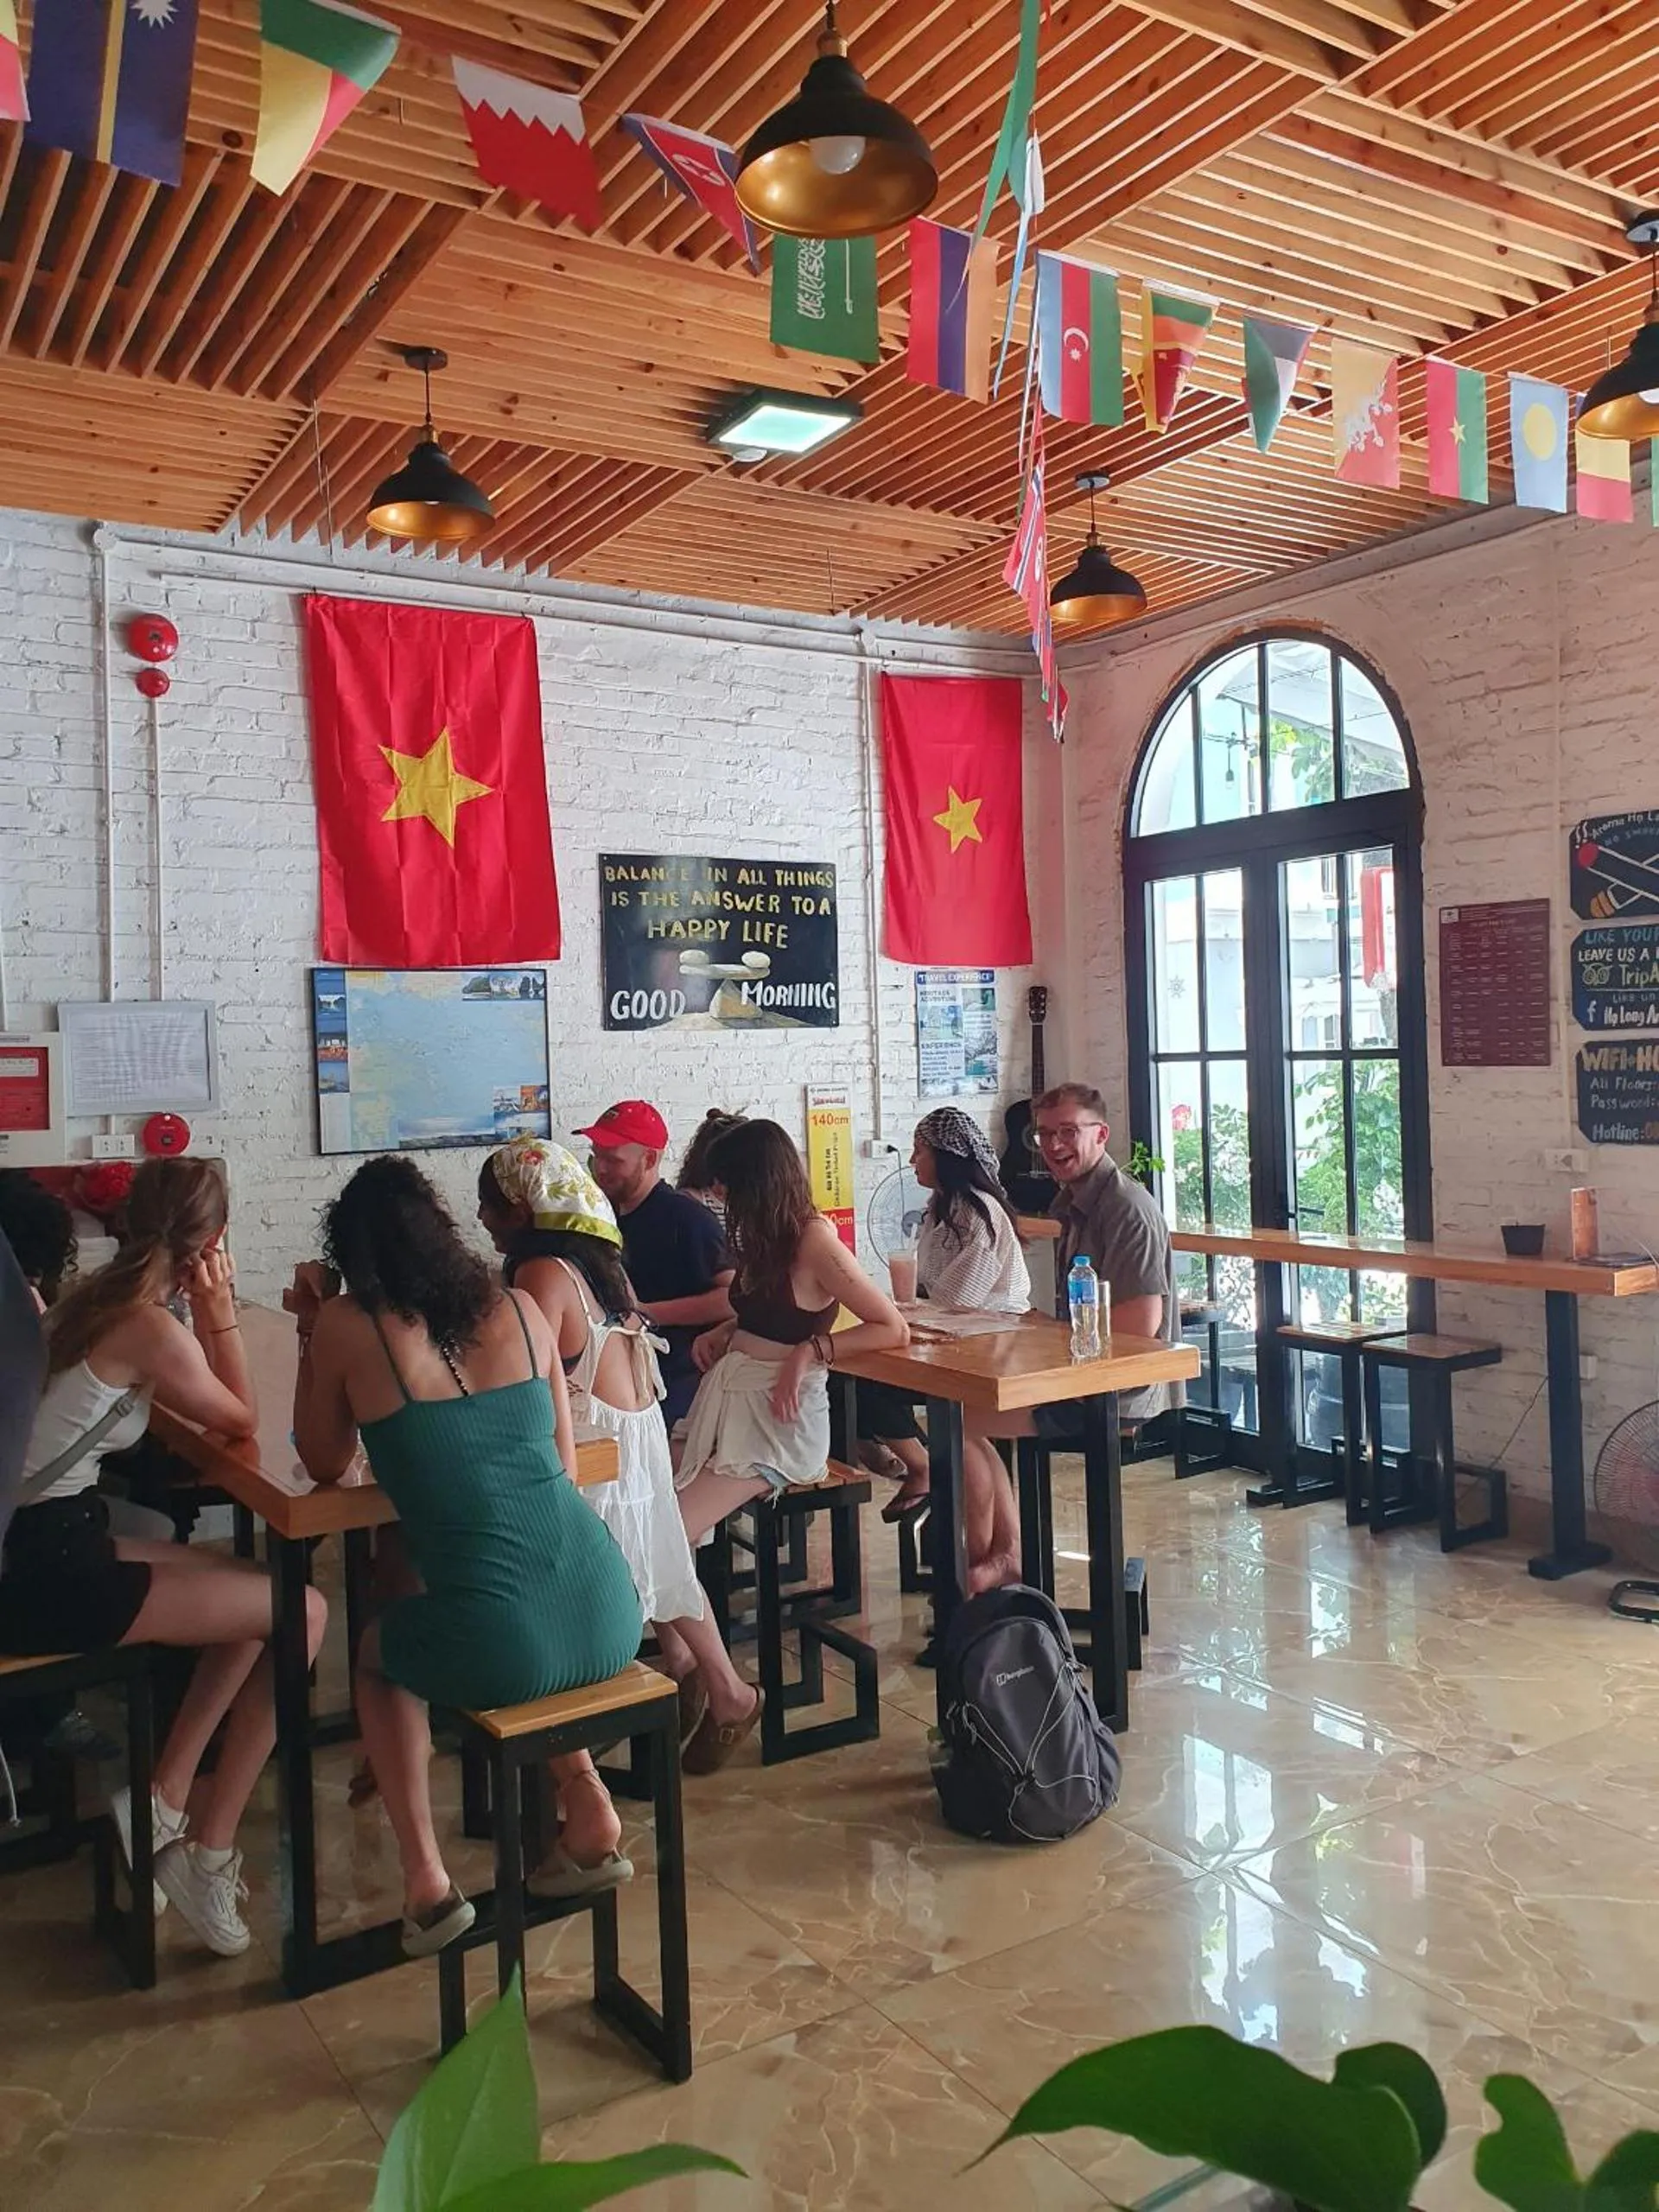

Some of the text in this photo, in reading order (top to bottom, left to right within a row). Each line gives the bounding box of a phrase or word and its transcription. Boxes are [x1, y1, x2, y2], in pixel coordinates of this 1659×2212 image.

[707, 867, 728, 882] IN
[737, 868, 767, 886] ALL
[775, 869, 834, 888] THINGS
[611, 891, 630, 907] IS
[638, 891, 680, 906] THE
[691, 890, 780, 913] ANSWER
[648, 918, 789, 949] HAPPY LIFE
[1579, 948, 1613, 963] LEAVE
[1618, 947, 1636, 963] US
[1640, 948, 1649, 961] A
[610, 981, 836, 1020] GOOD MORNING
[1619, 1005, 1645, 1027] Long
[811, 1114, 849, 1126] 140cm
[830, 1213, 853, 1224] 0cm
